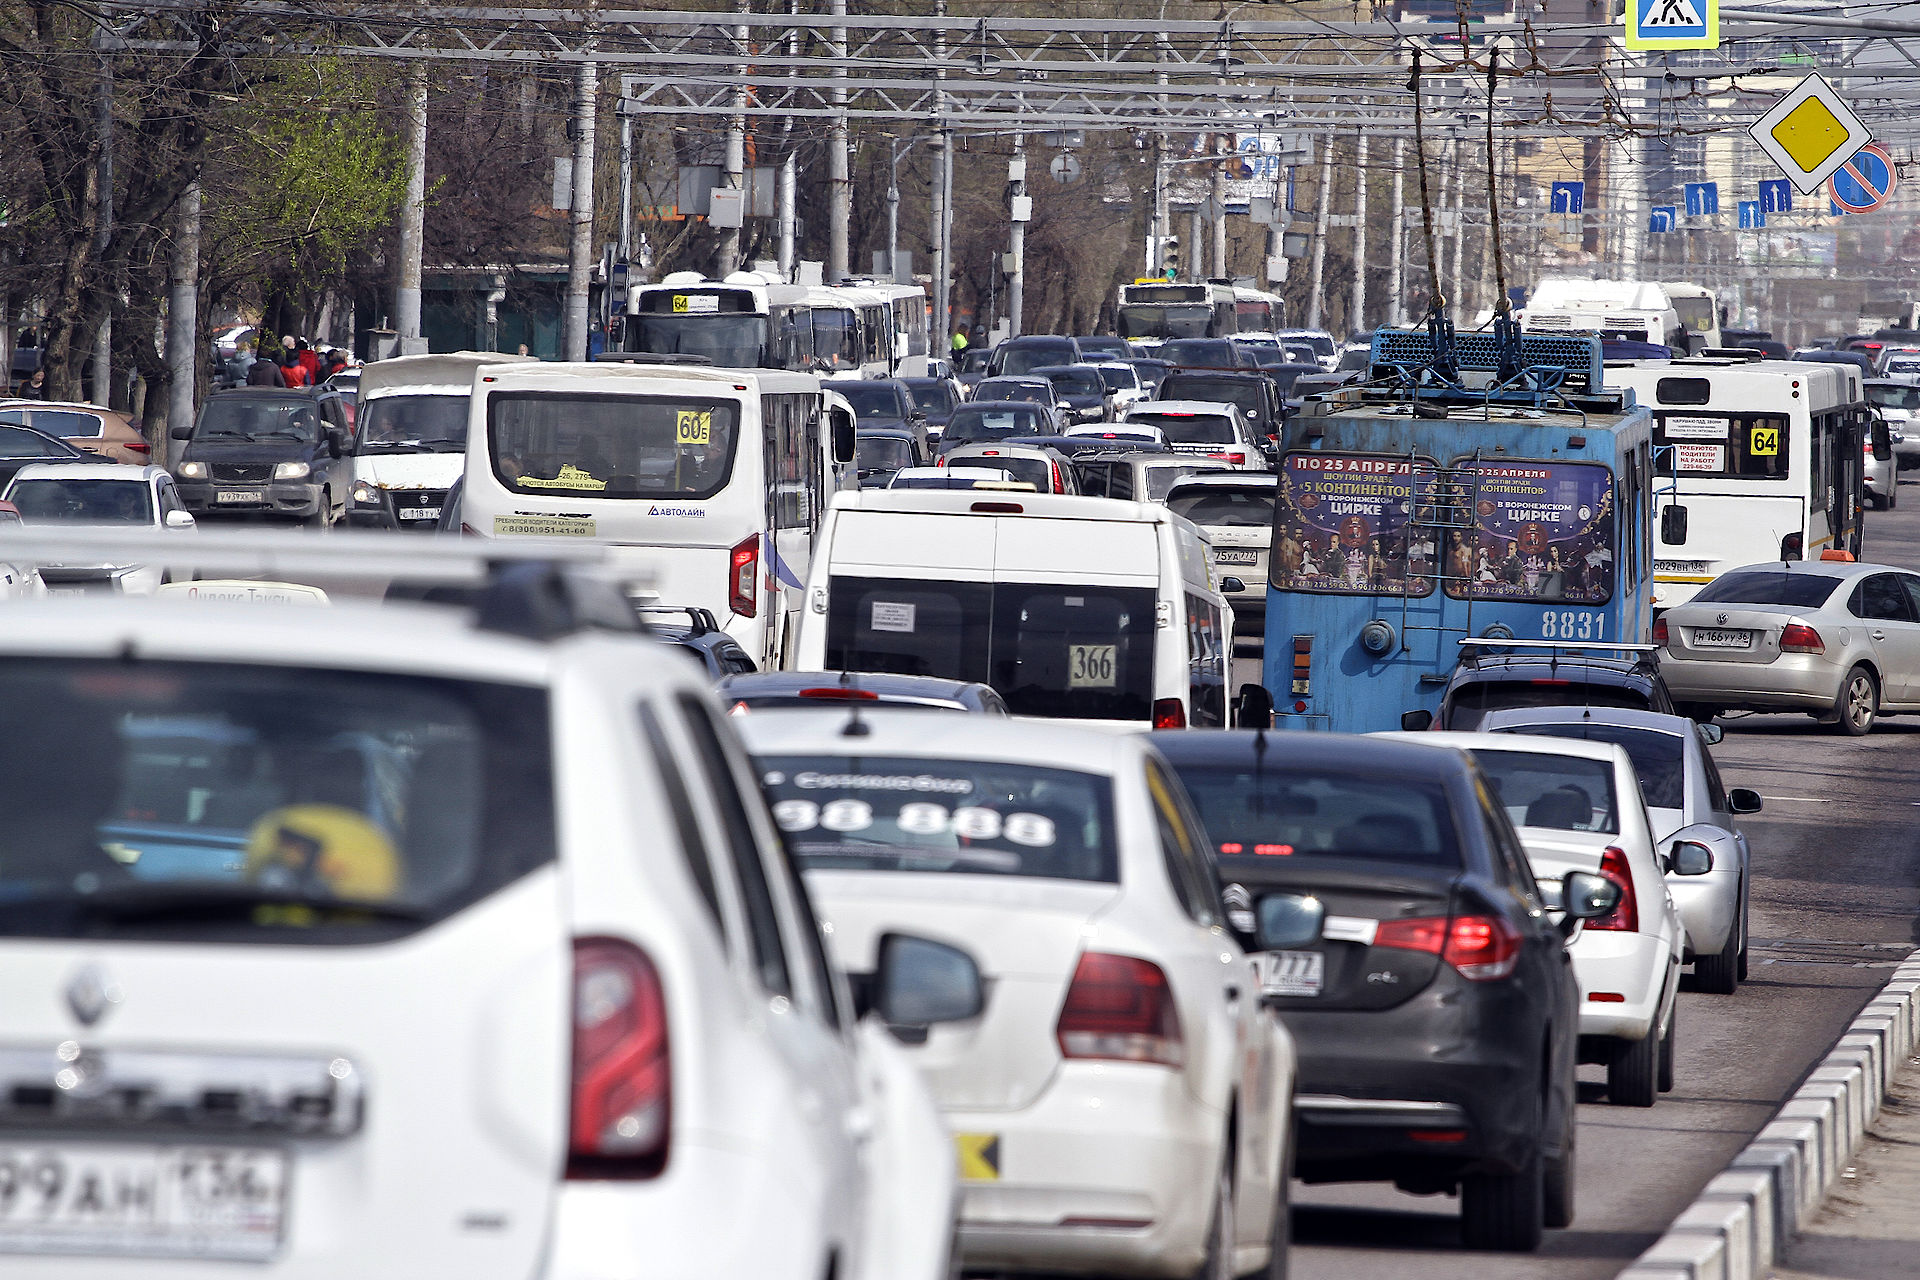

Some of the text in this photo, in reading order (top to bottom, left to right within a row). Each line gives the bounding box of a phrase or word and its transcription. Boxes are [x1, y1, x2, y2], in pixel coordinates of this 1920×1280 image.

[674, 297, 688, 310] 64
[1754, 432, 1777, 452] 64
[1297, 458, 1320, 469] ПО
[1324, 460, 1344, 470] 25
[1328, 495, 1394, 504] ВОРОНЕЖСКОМ
[660, 507, 705, 517] АВТОЛАЙН
[1330, 502, 1382, 515] ЦИРКЕ
[1506, 502, 1571, 511] ВОРОНЕЖСКОМ
[1508, 510, 1560, 522] ЦИРКЕ
[1542, 611, 1604, 639] 8831
[1074, 647, 1112, 680] 366
